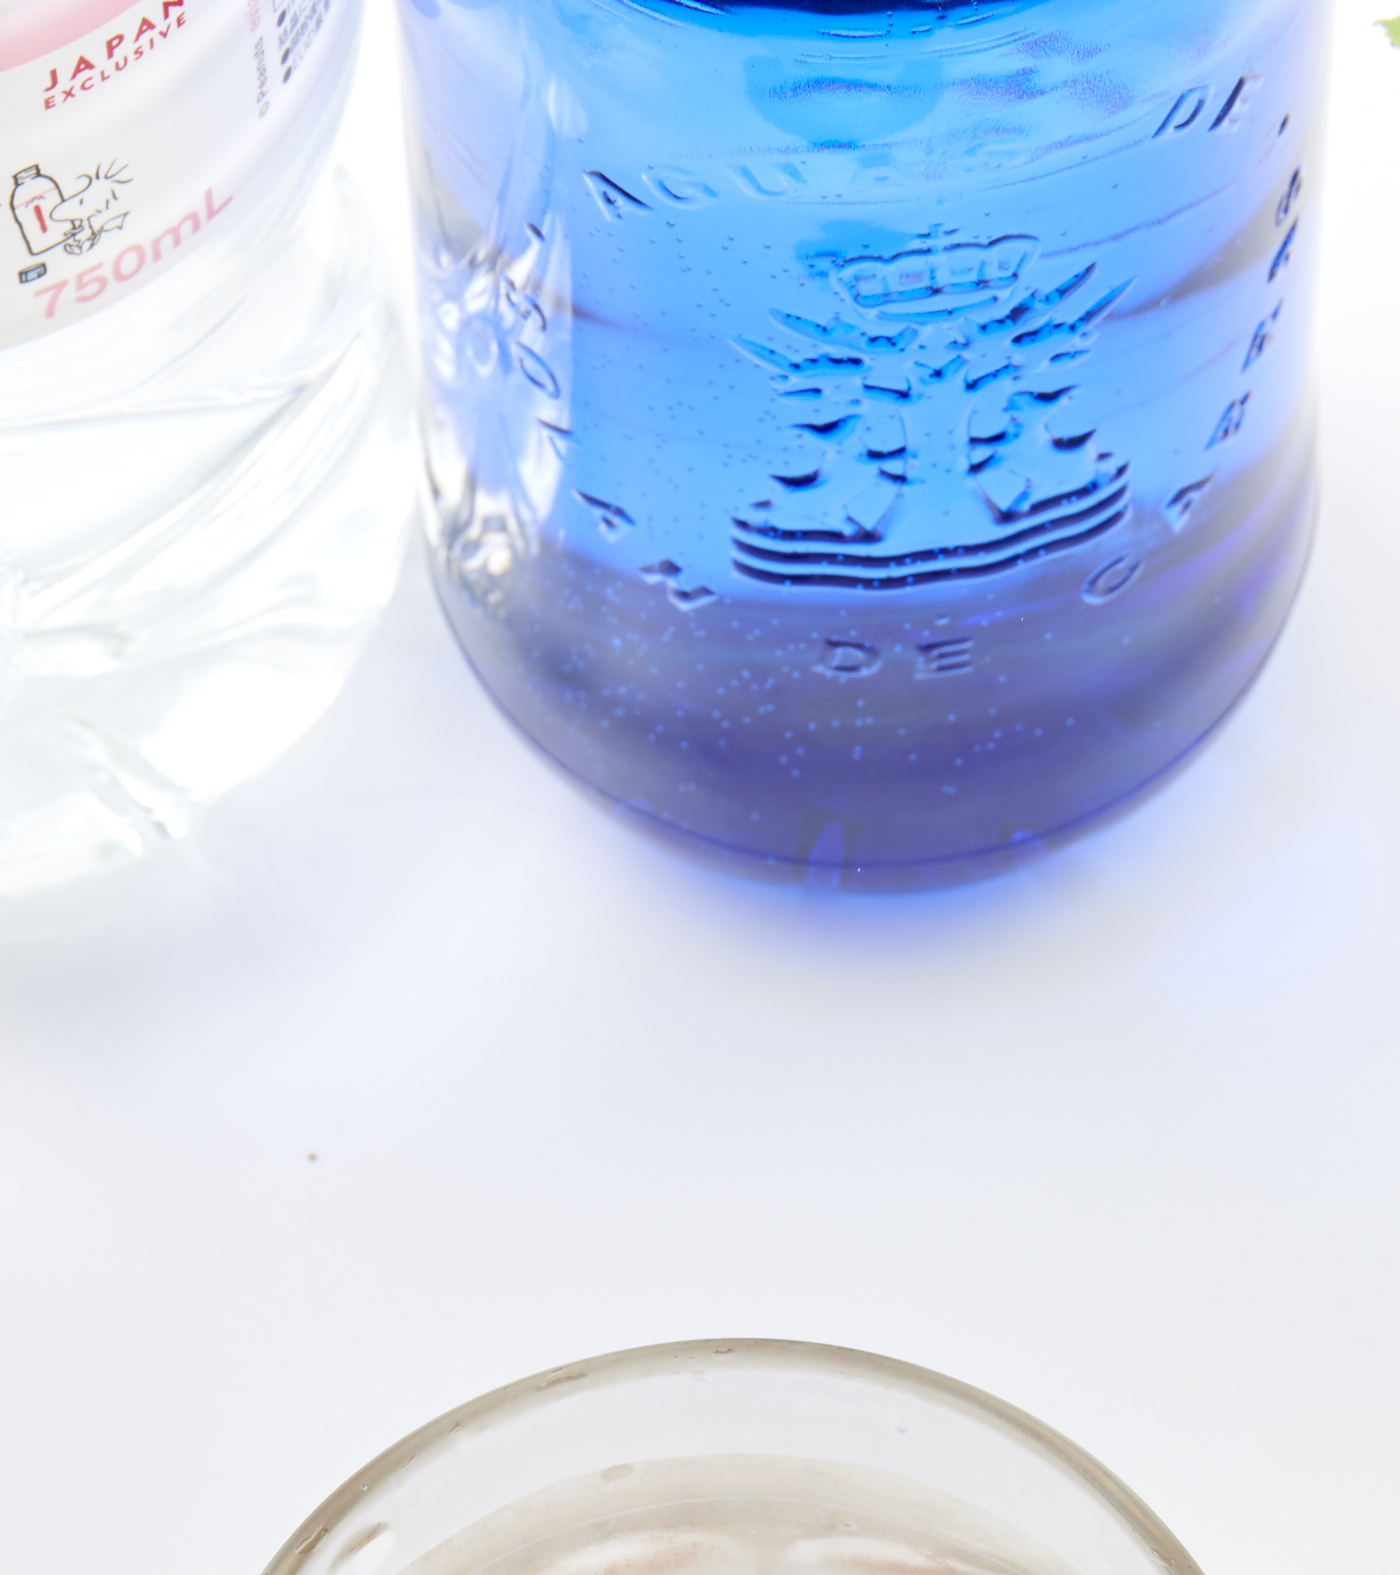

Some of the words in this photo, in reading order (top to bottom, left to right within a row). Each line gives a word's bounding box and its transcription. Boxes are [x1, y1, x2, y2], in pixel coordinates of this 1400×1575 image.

[43, 11, 186, 110] EXCLUSIVE
[33, 187, 234, 320] 750mL
[811, 637, 976, 681] DE
